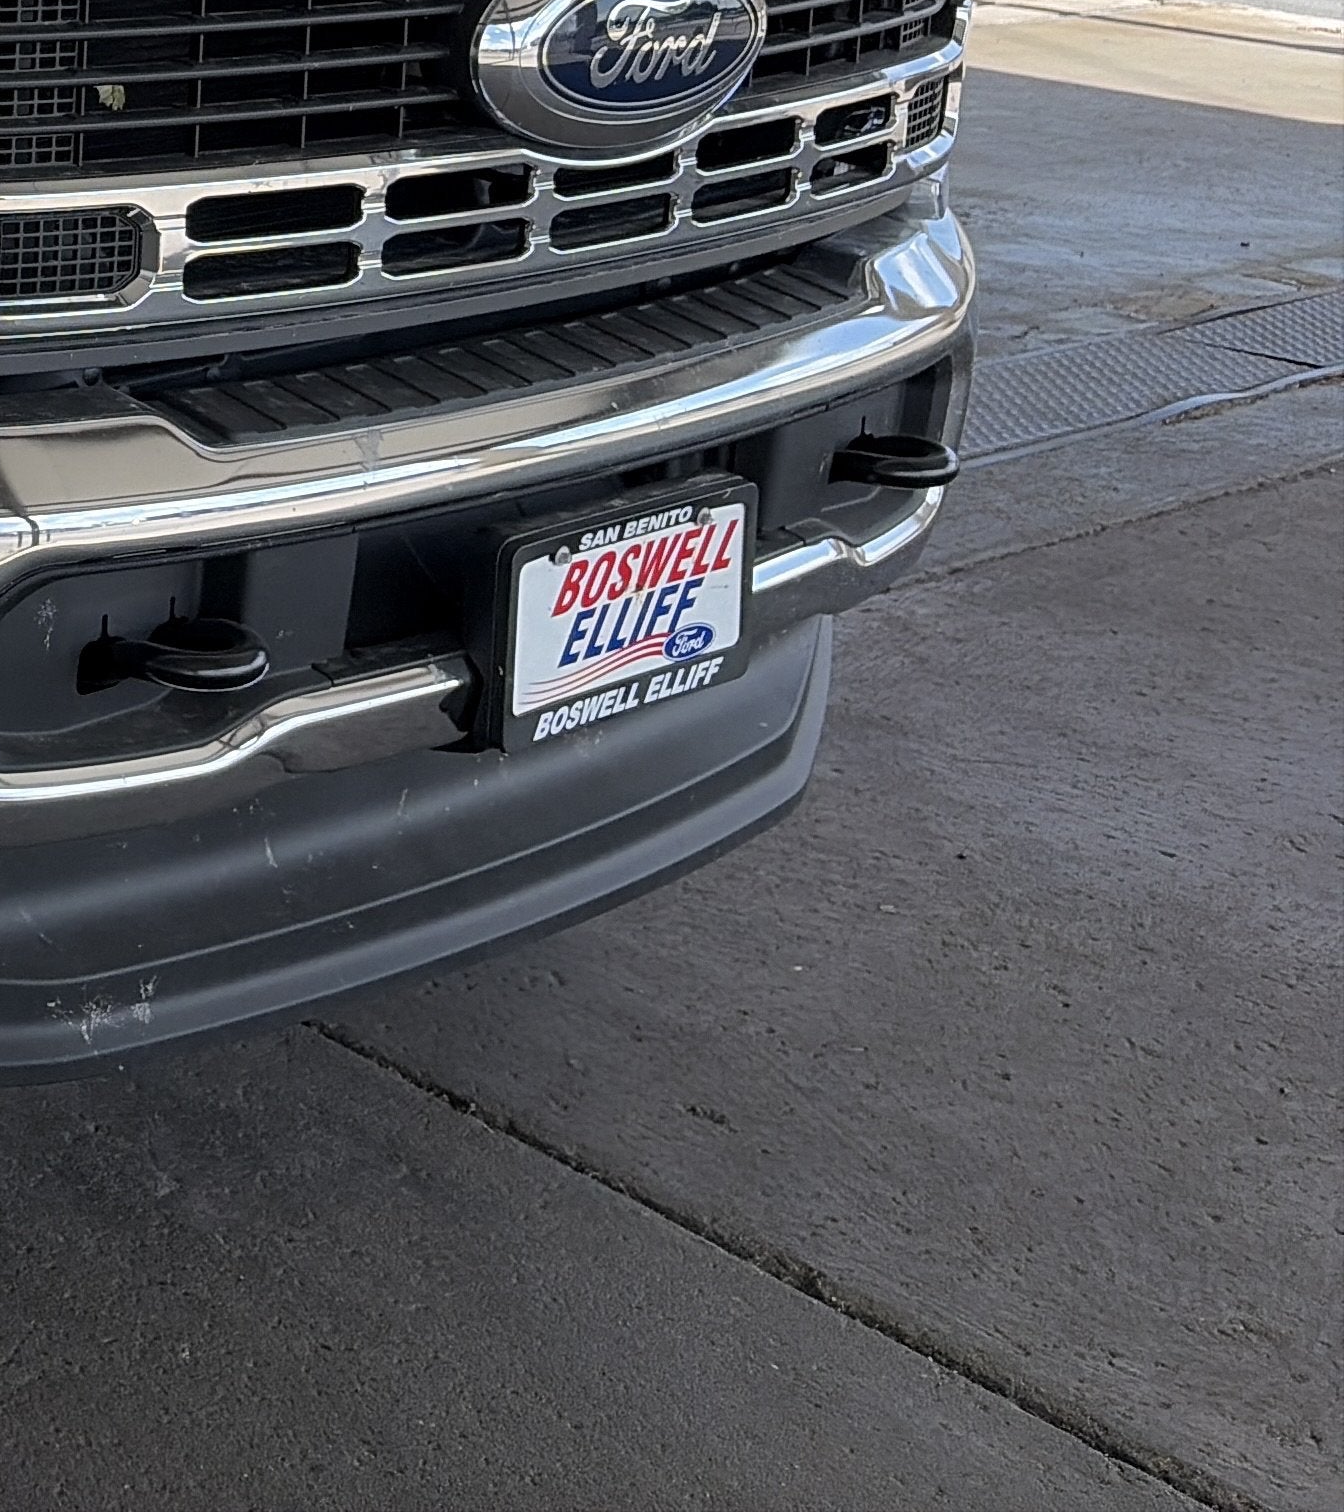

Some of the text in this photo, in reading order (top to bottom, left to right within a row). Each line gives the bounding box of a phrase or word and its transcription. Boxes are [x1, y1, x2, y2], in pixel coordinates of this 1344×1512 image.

[551, 519, 739, 617] BOSWELL
[579, 505, 693, 551] SAN BENITO
[558, 577, 705, 668] ELLIFF
[672, 629, 704, 655] Ford
[534, 656, 724, 741] BOSWELL ELLIFF
